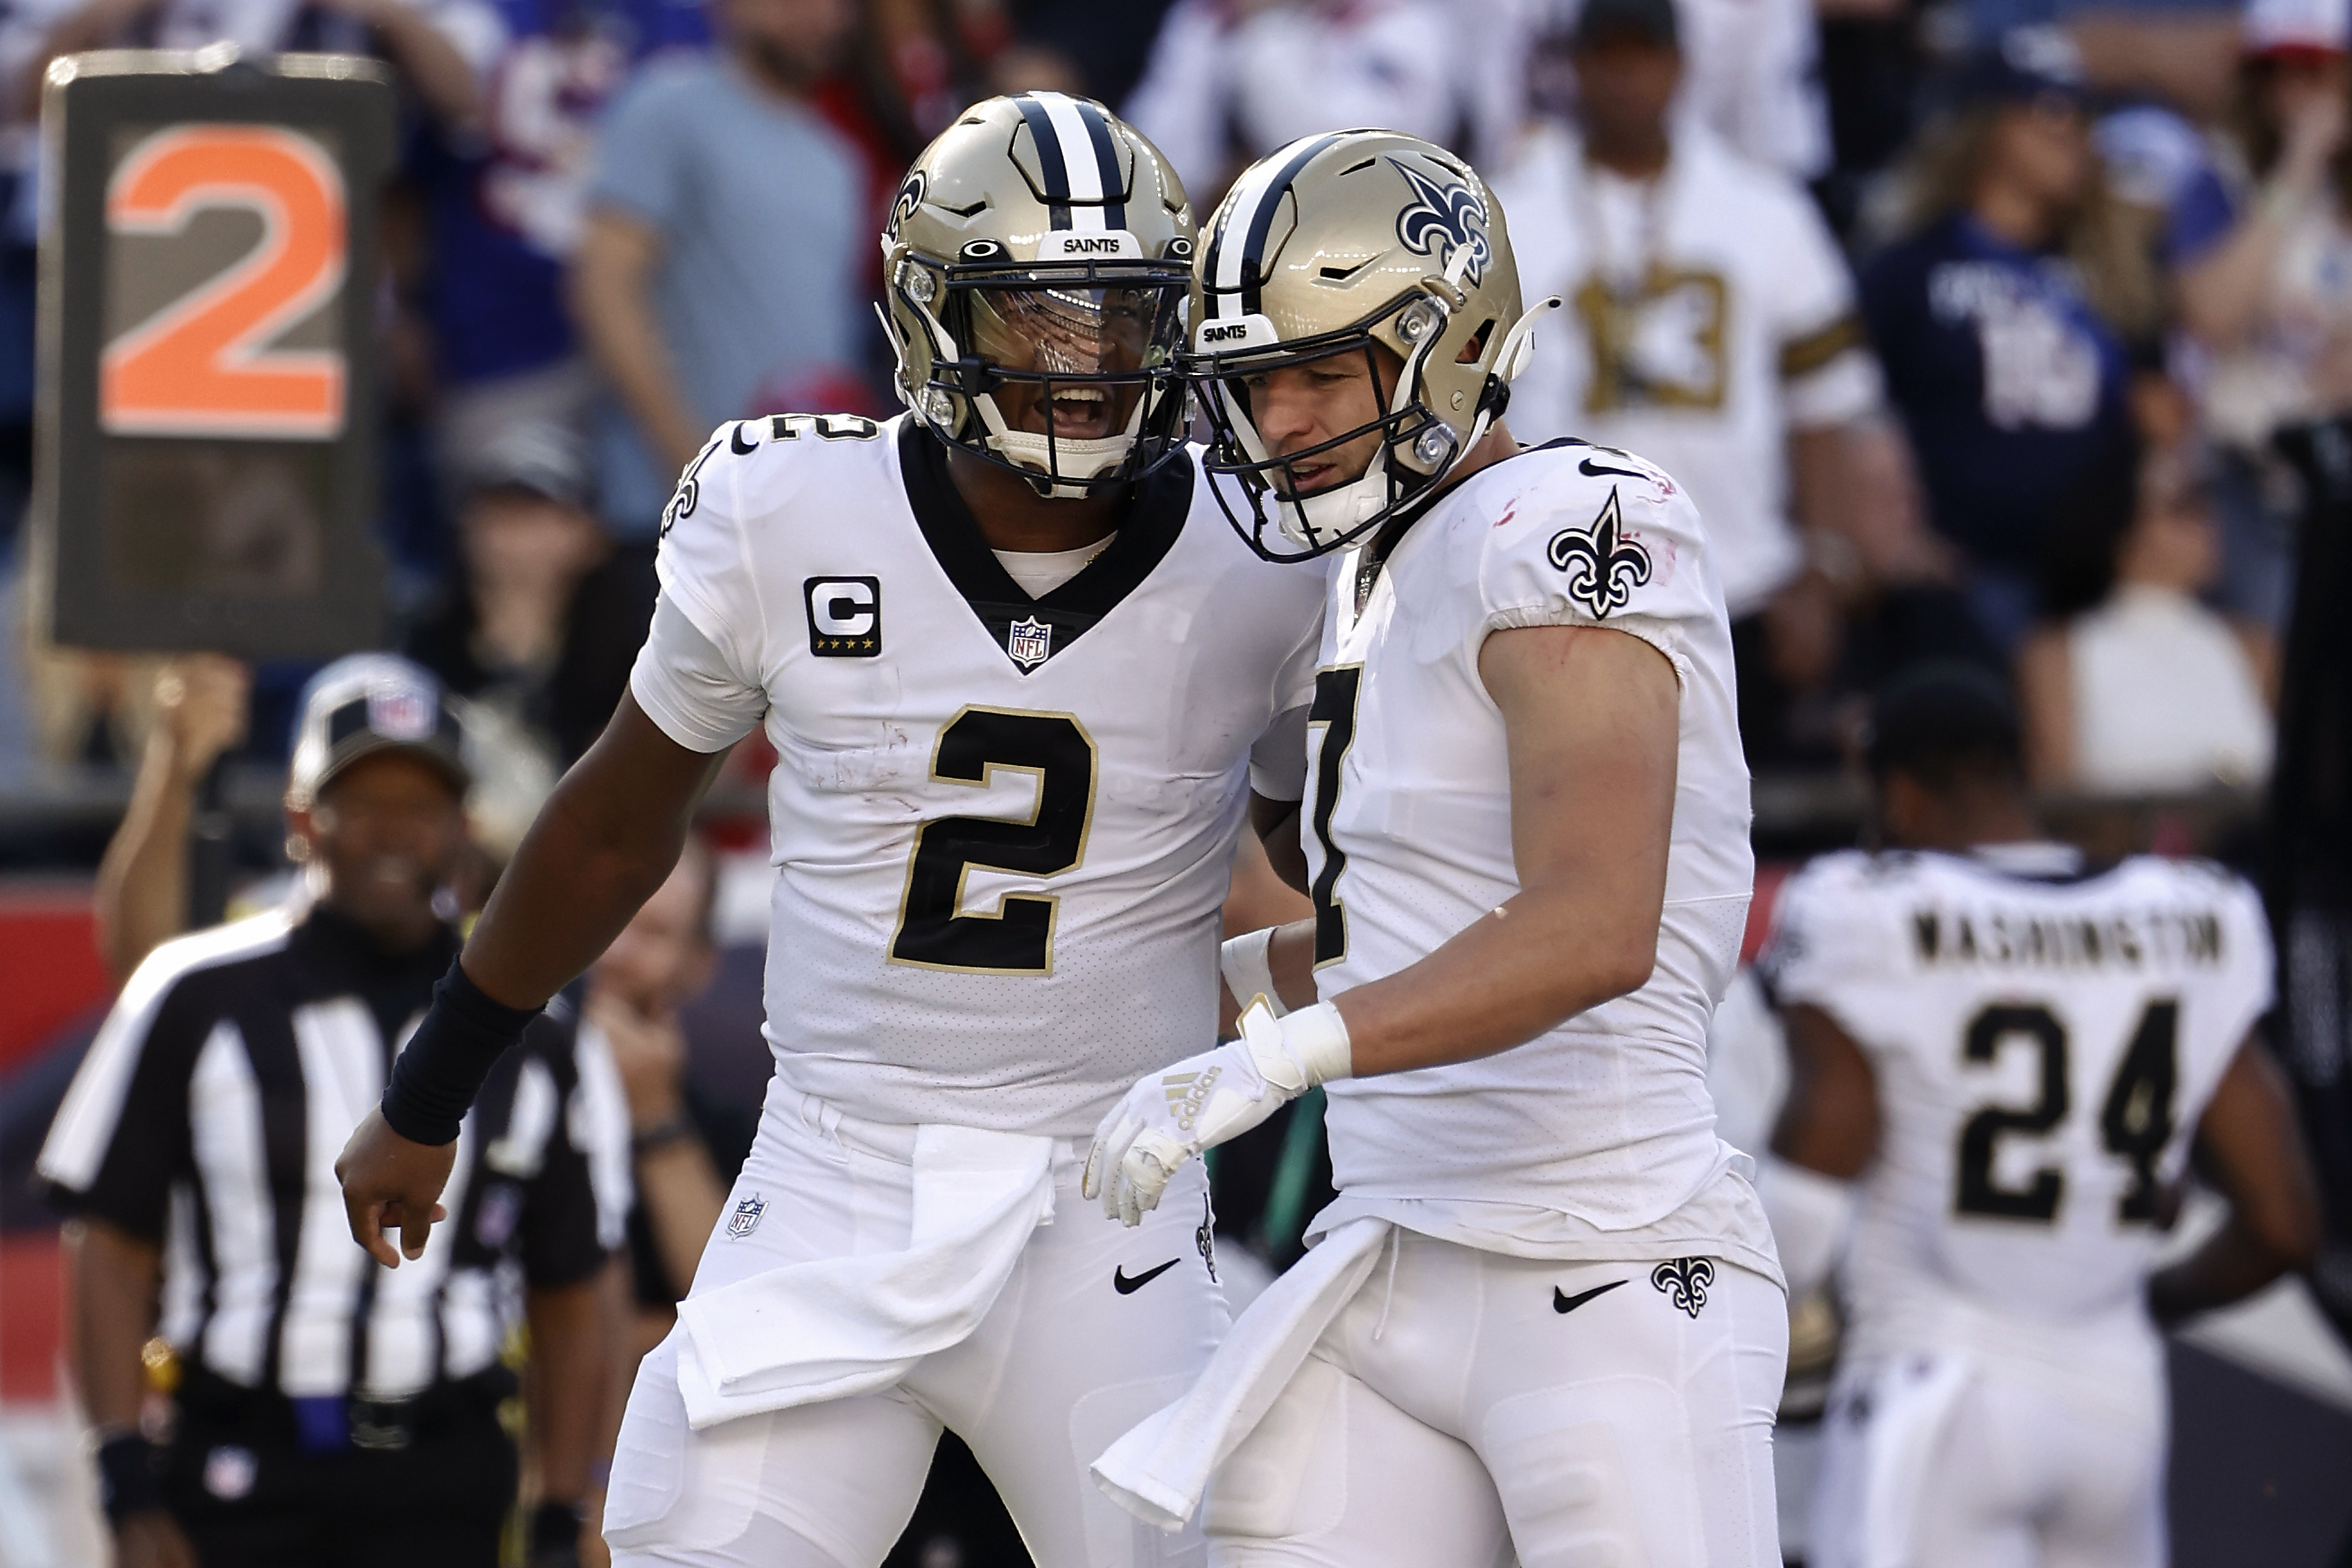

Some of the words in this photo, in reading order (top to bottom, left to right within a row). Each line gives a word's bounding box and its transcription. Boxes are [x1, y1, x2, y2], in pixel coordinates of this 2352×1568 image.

[1064, 239, 1119, 253] SAINTS
[100, 123, 348, 441] 2
[1204, 324, 1247, 342] SAINTS
[811, 581, 874, 636] C
[1015, 638, 1043, 658] NFL
[886, 702, 1099, 977] 2
[1178, 1066, 1223, 1131] adidas
[1953, 992, 2181, 1225] 24
[731, 1213, 754, 1231] NFL
